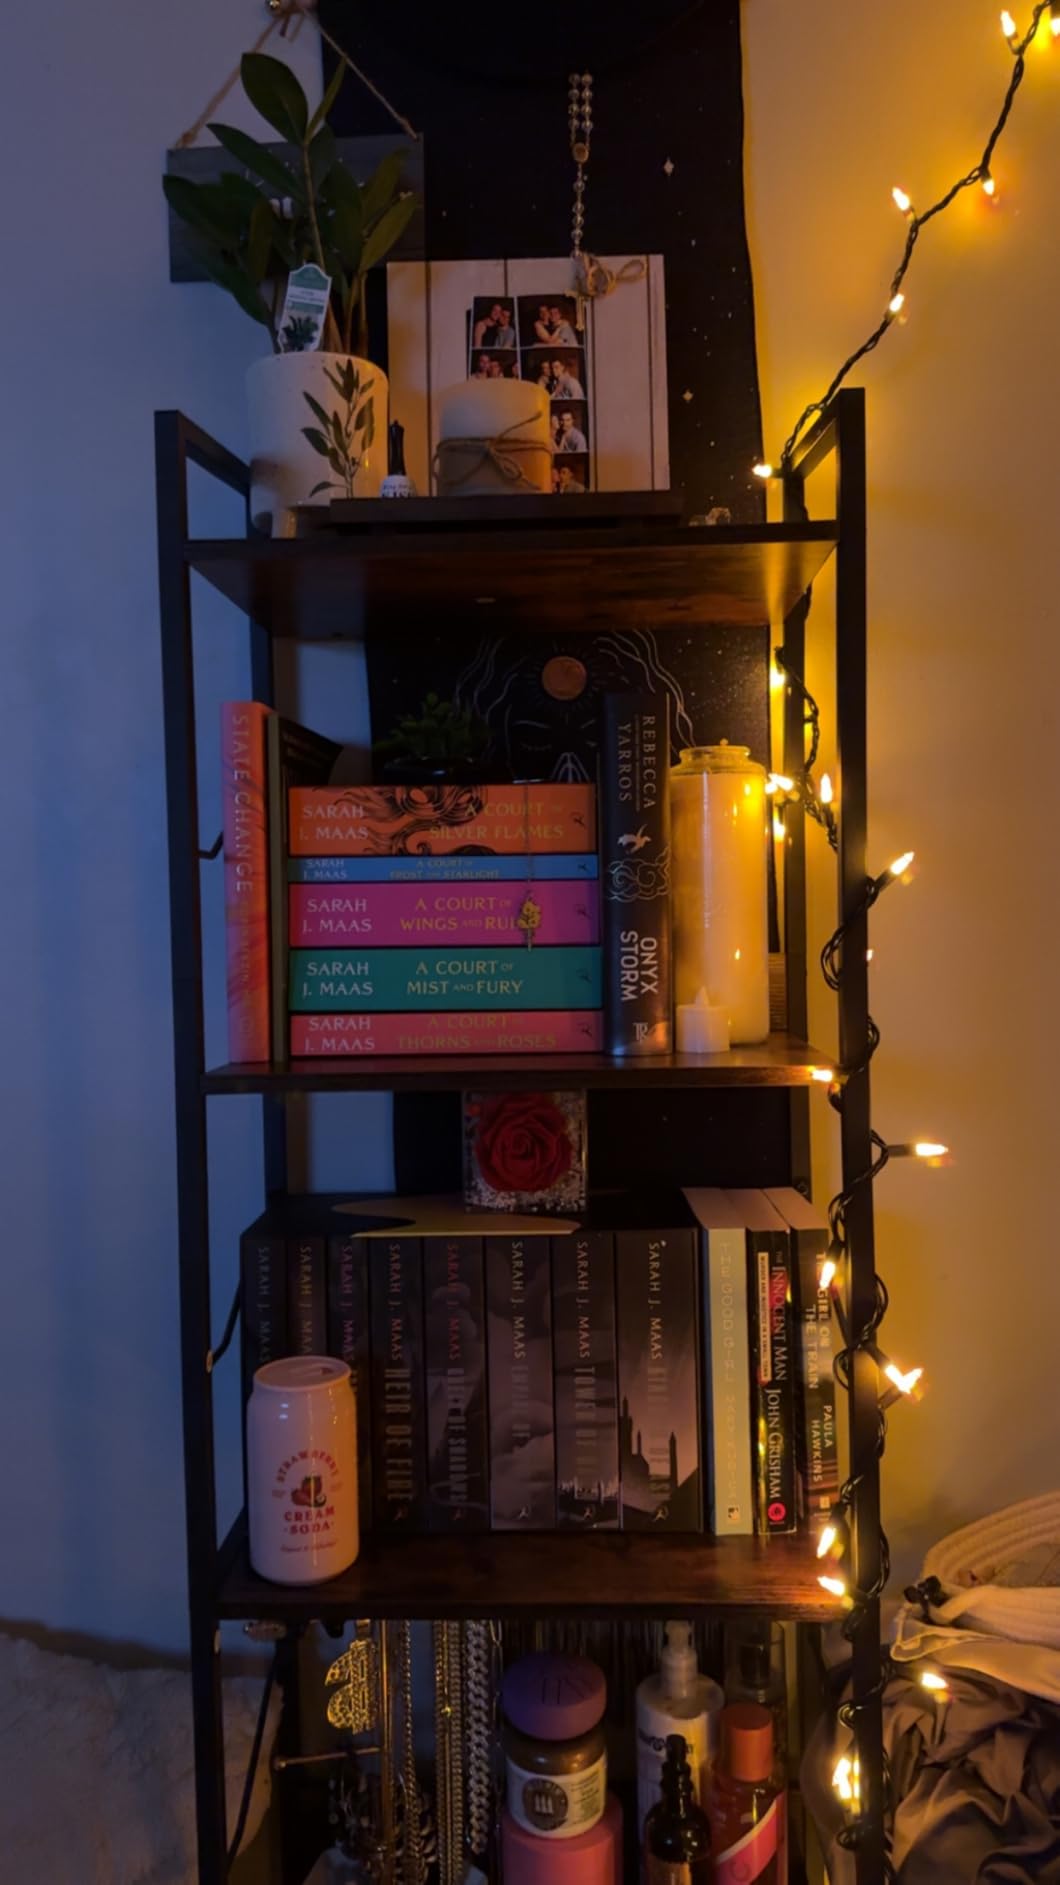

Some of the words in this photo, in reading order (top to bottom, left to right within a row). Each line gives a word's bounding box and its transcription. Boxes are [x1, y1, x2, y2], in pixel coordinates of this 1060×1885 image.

[232, 714, 250, 781] STATE
[617, 722, 632, 802] YARROS
[642, 715, 657, 810] REBECCA
[303, 805, 365, 819] SARAH
[464, 802, 478, 816] A
[484, 801, 546, 816] COURT
[233, 791, 252, 893] CHANGE
[316, 825, 370, 841] MAAS
[429, 825, 488, 841] SILVER
[494, 824, 565, 840] FLAMES
[306, 858, 345, 868] SARAH
[314, 870, 348, 880] MAAS
[390, 870, 423, 880] FROST
[443, 870, 500, 880] STARLIGHT
[416, 860, 424, 869] A
[426, 859, 463, 869] COURT
[306, 898, 368, 913] SARAH
[415, 898, 428, 912] A
[434, 897, 497, 912] COURT
[302, 919, 313, 935] J.
[319, 918, 373, 933] MAAS
[400, 917, 458, 931] WINGS
[485, 916, 521, 930] RUI
[306, 961, 370, 977] SARAH
[415, 961, 429, 976] A
[435, 960, 498, 976] COURT
[500, 962, 514, 971] OF
[619, 930, 638, 1002] STORM
[640, 937, 659, 995] ONYX
[302, 982, 313, 998] J.
[320, 981, 374, 997] MAAS
[406, 980, 449, 994] MIST
[453, 983, 474, 992] AND
[476, 980, 524, 995] FURY
[308, 1015, 371, 1032] SARAH
[427, 1016, 440, 1029] A
[447, 1014, 508, 1029] COURT
[304, 1037, 314, 1053] J.
[320, 1036, 376, 1052] MAAS
[399, 1034, 471, 1049] THORNS
[498, 1034, 558, 1048] ROSES
[257, 1246, 270, 1295] SARAH
[300, 1246, 313, 1295] SARAH
[342, 1245, 353, 1294] SARAH
[388, 1243, 401, 1293] SARAH
[446, 1243, 459, 1295] SARAH
[511, 1240, 525, 1290] SARAH
[576, 1240, 590, 1291] SARAH
[647, 1241, 663, 1292] SARAH
[720, 1242, 733, 1278] THE
[510, 1297, 525, 1309] J.
[575, 1297, 589, 1309] J.
[647, 1297, 663, 1309] J.
[721, 1282, 735, 1330] GOOD
[772, 1265, 787, 1342] INNOCENT
[804, 1304, 817, 1336] THE
[817, 1288, 830, 1321] GIRL
[300, 1319, 313, 1354] MAA
[390, 1317, 402, 1361] MAAS
[448, 1317, 460, 1361] MAAS
[512, 1316, 526, 1361] MAAS
[577, 1315, 590, 1359] MAAS
[649, 1317, 665, 1361] MAAS
[819, 1326, 831, 1347] ON
[723, 1337, 736, 1384] GIRL
[774, 1346, 789, 1381] MAN
[807, 1342, 820, 1389] TRAIN
[384, 1368, 412, 1413] HEIR
[574, 1366, 596, 1421] TOWER
[764, 1388, 783, 1428] JOHN
[385, 1424, 412, 1448] OF
[823, 1405, 834, 1448] PAULA
[768, 1432, 784, 1499] GRISHAM
[811, 1420, 823, 1482] HAWKINS
[386, 1458, 412, 1502] FIRE
[284, 1505, 335, 1522] CREAM
